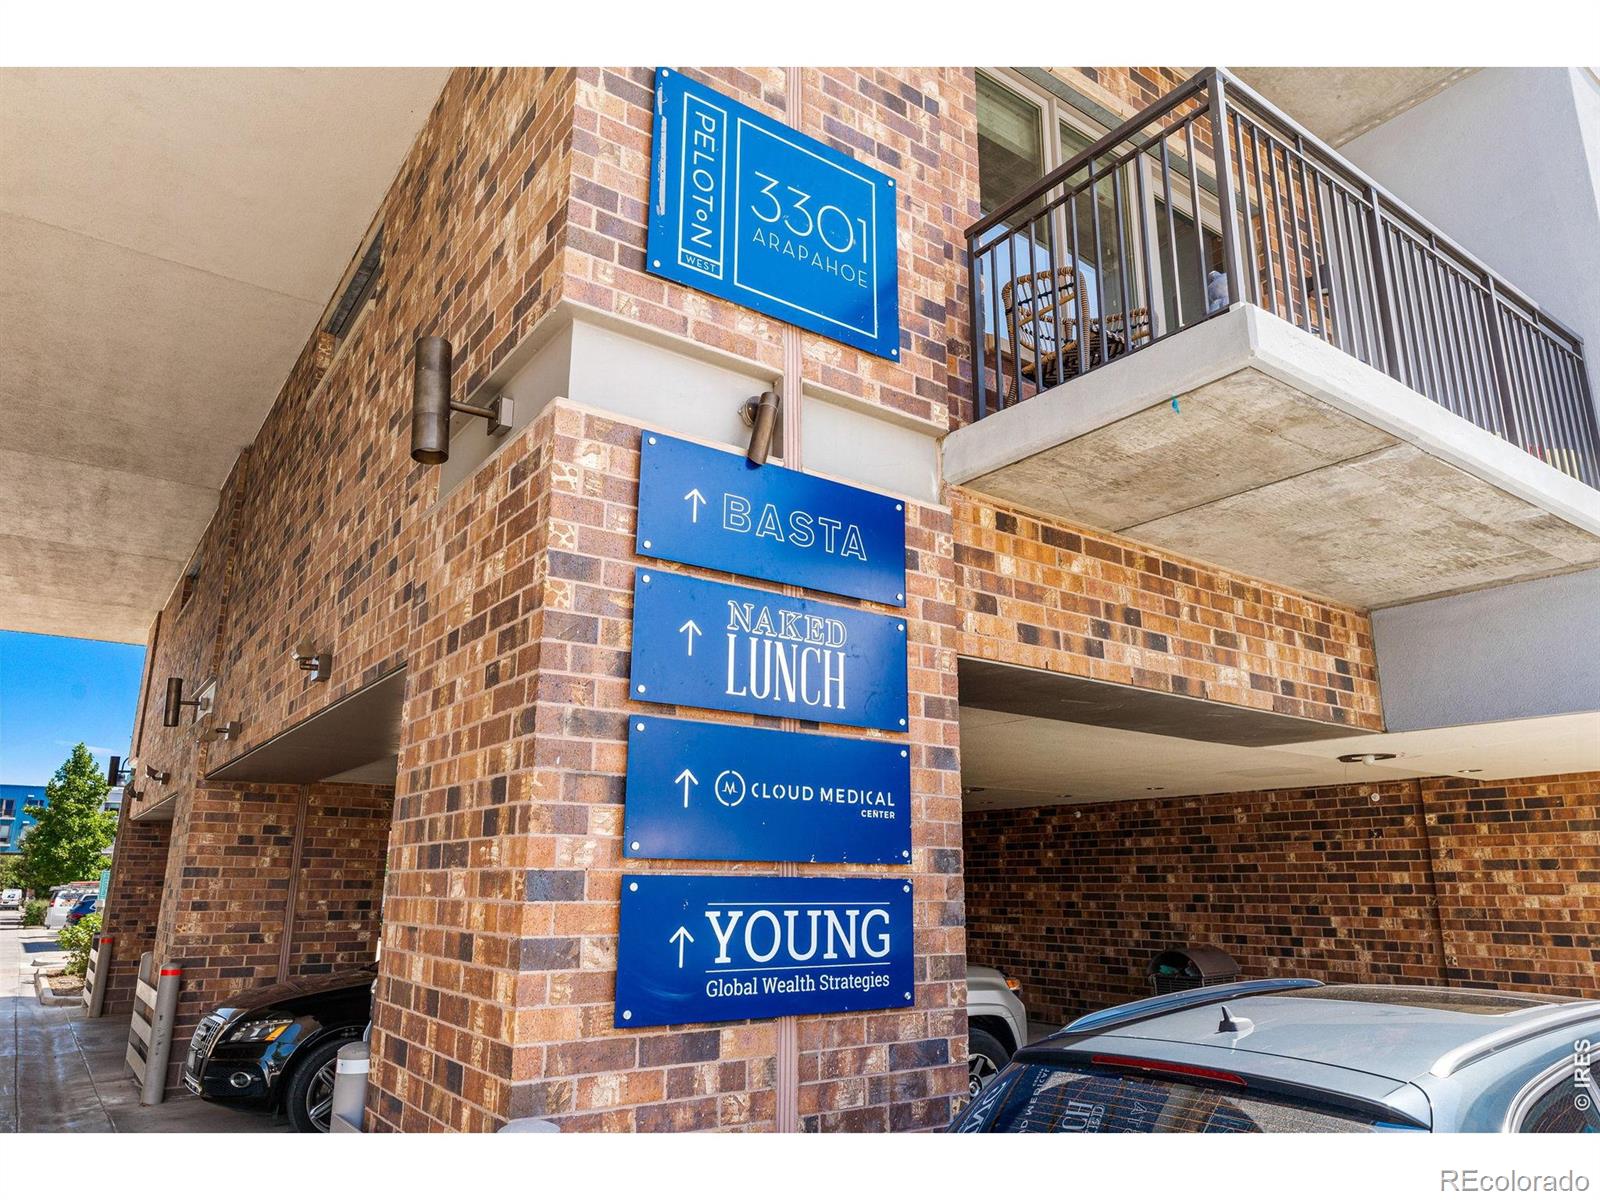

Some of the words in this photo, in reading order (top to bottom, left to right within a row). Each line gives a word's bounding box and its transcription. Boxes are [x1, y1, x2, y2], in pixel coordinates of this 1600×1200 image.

[751, 170, 867, 264] 3301
[685, 254, 717, 273] WEST
[752, 227, 868, 289] ARAPAHOE
[723, 493, 867, 561] BASTA
[726, 600, 848, 648] NAKED
[726, 633, 846, 710] LUNCH
[751, 782, 814, 801] CLOUD
[820, 787, 896, 807] MEDICAL
[860, 809, 896, 820] CENTER
[705, 908, 891, 964] YOUNG
[705, 977, 758, 998] Global
[762, 973, 816, 994] Wealth
[819, 971, 890, 992] Strategies
